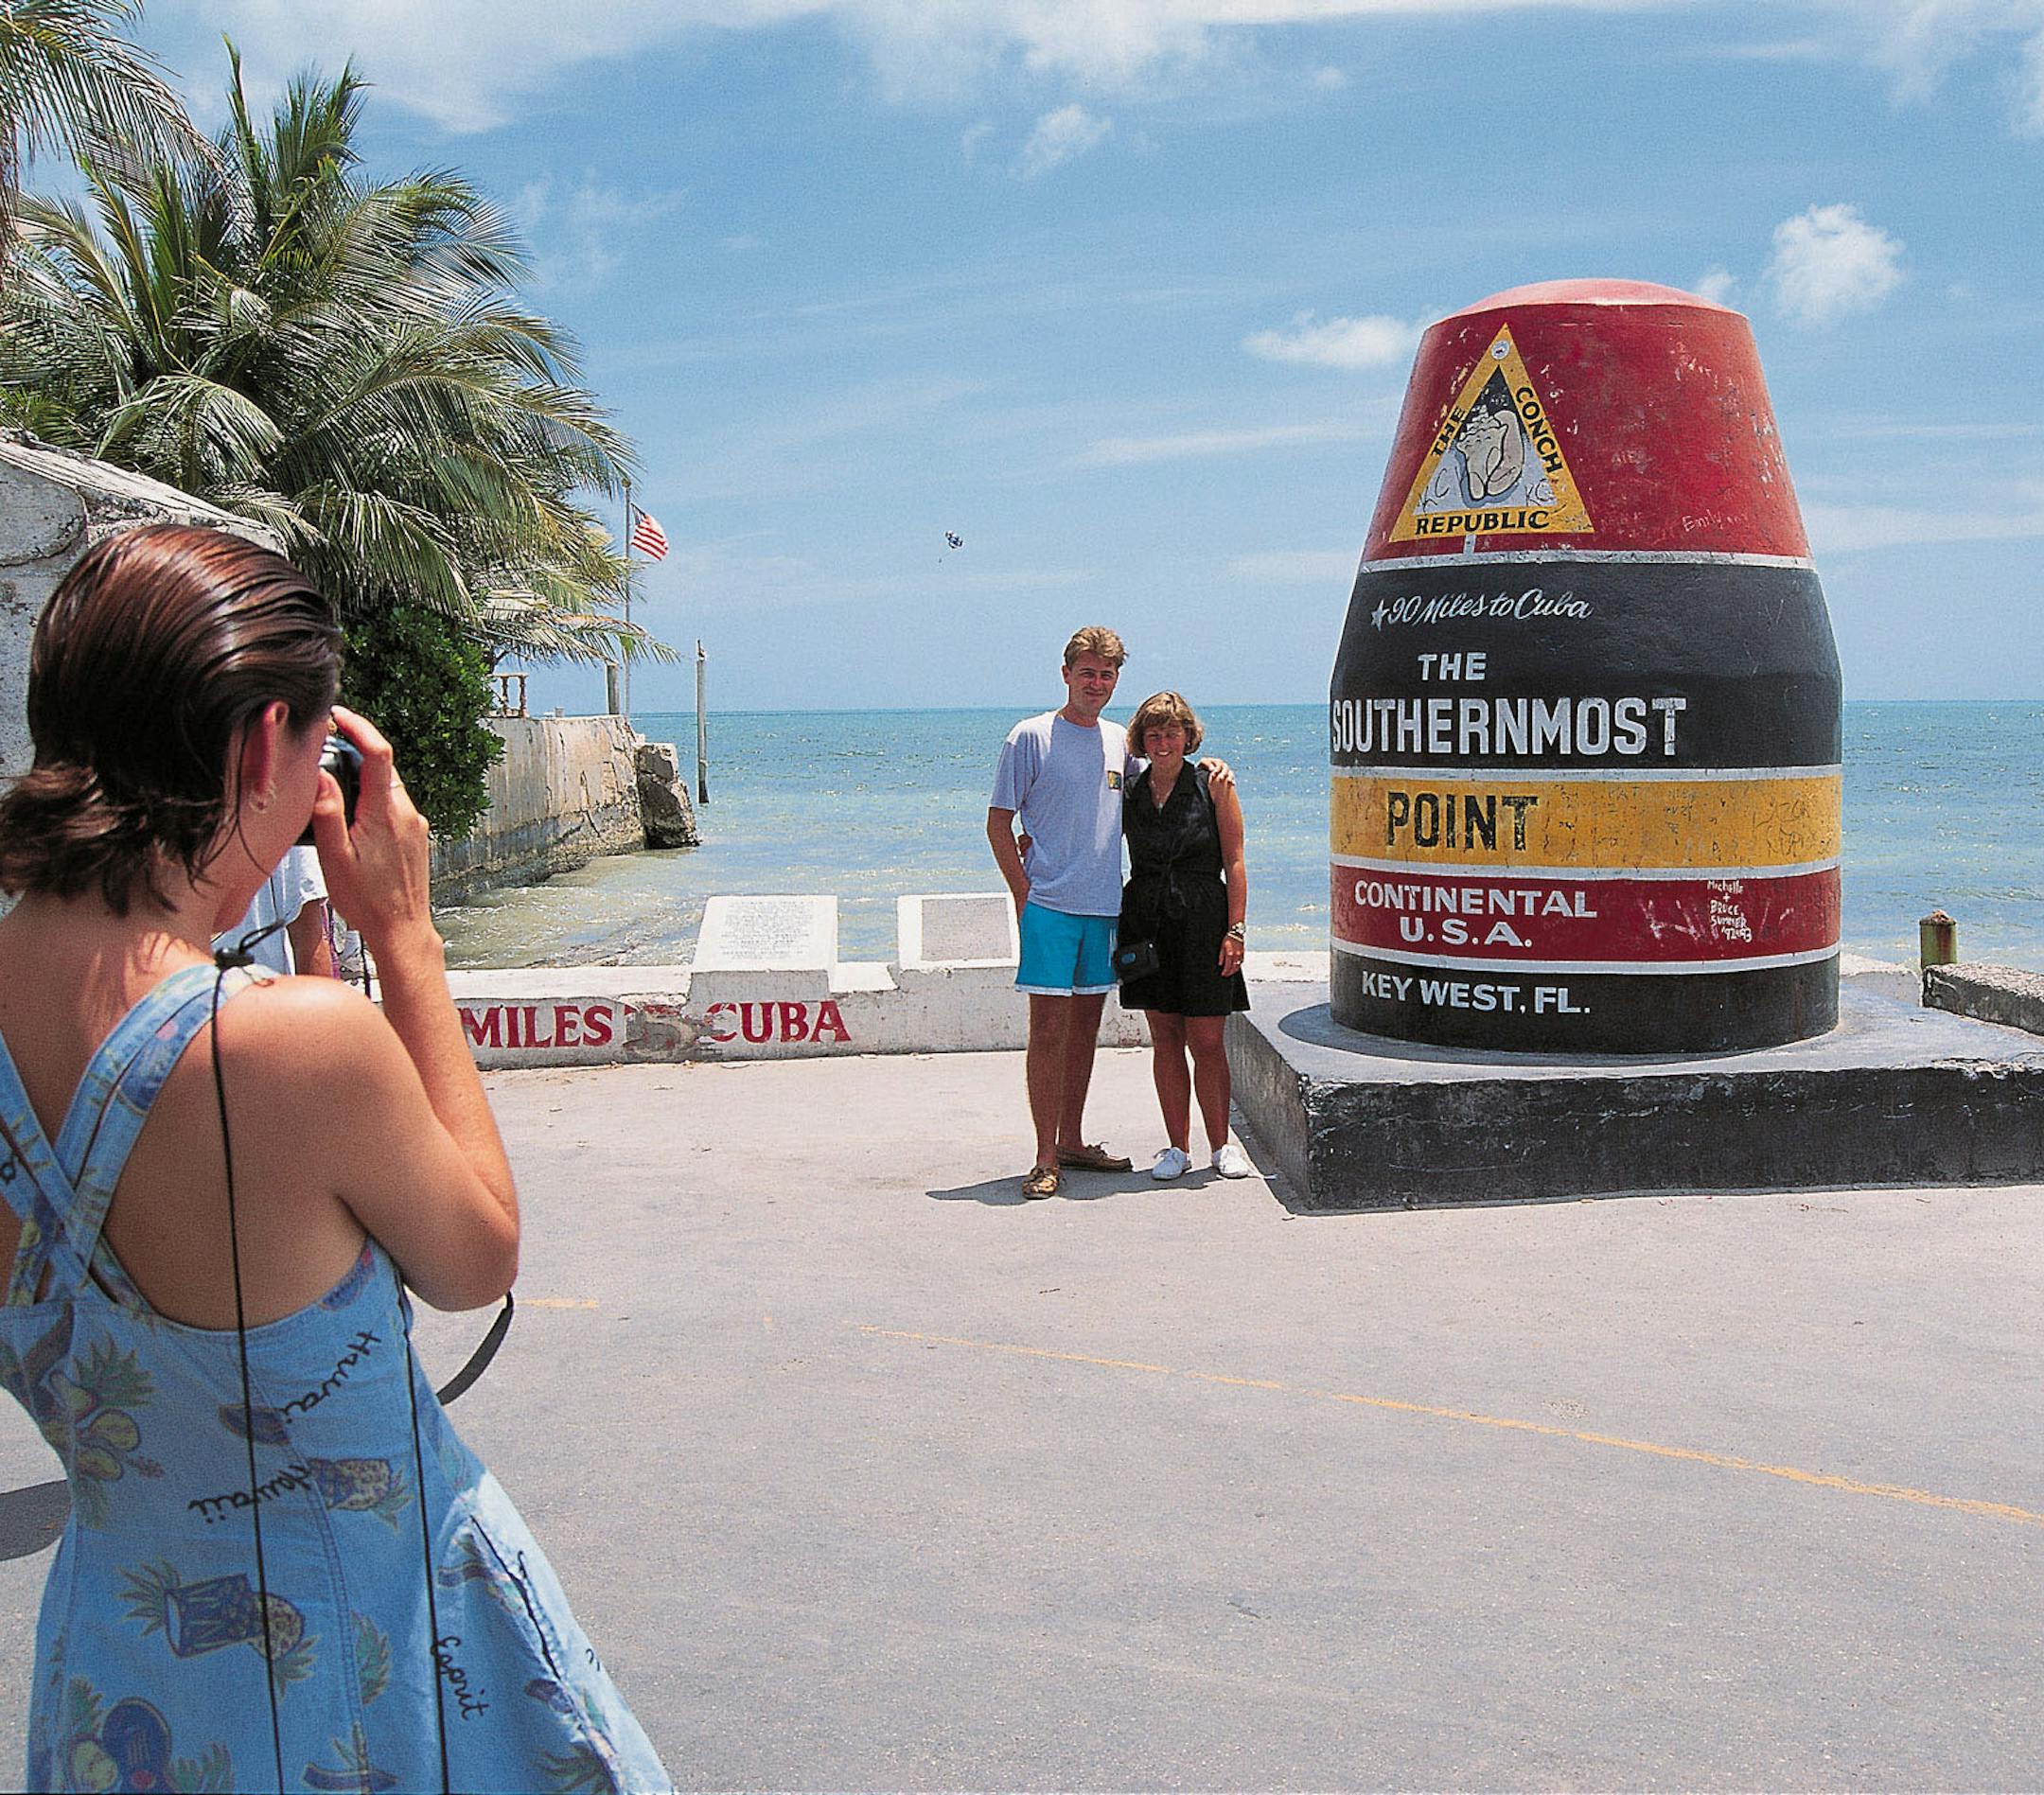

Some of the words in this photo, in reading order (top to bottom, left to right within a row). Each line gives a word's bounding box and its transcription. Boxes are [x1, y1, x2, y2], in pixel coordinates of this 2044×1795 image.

[1430, 407, 1466, 456] THE
[1516, 387, 1562, 473] CONCH
[1415, 510, 1550, 536] REPUBLIC
[1387, 595, 1422, 625] 90
[1413, 592, 1489, 625] Miles
[1489, 591, 1515, 617] to
[1514, 589, 1595, 620] Cuba
[1418, 652, 1487, 681] THE
[1332, 697, 1687, 755] SOUTHERNMOST
[1386, 791, 1538, 851] POINT
[1354, 880, 1597, 918] CONTINENTAL
[1400, 917, 1532, 947] U.S.A.
[1362, 971, 1413, 1001] KEY
[1419, 978, 1526, 1014] WEST,
[1534, 986, 1591, 1014] FL.
[458, 1005, 612, 1047] MILES
[704, 1000, 852, 1044] CUBA
